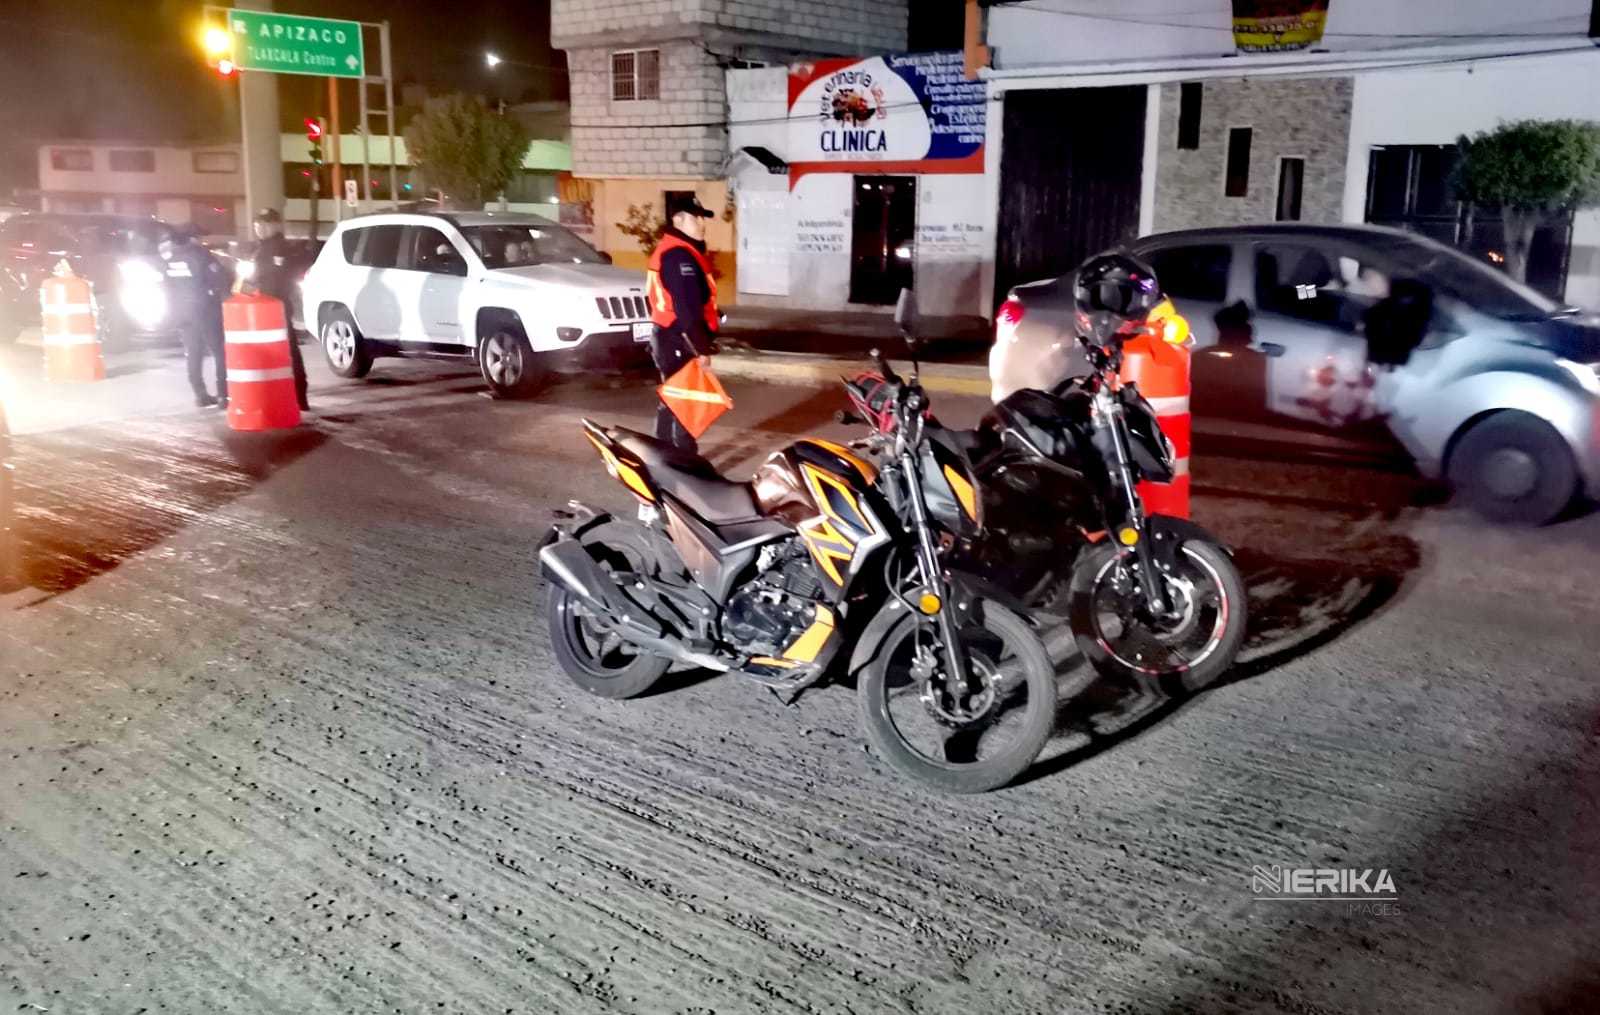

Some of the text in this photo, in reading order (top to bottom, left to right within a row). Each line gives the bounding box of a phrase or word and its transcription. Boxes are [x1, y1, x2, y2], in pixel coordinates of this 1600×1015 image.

[259, 23, 347, 44] APIZACO
[247, 46, 299, 63] TLAXCALA
[820, 130, 888, 152] CLINICA
